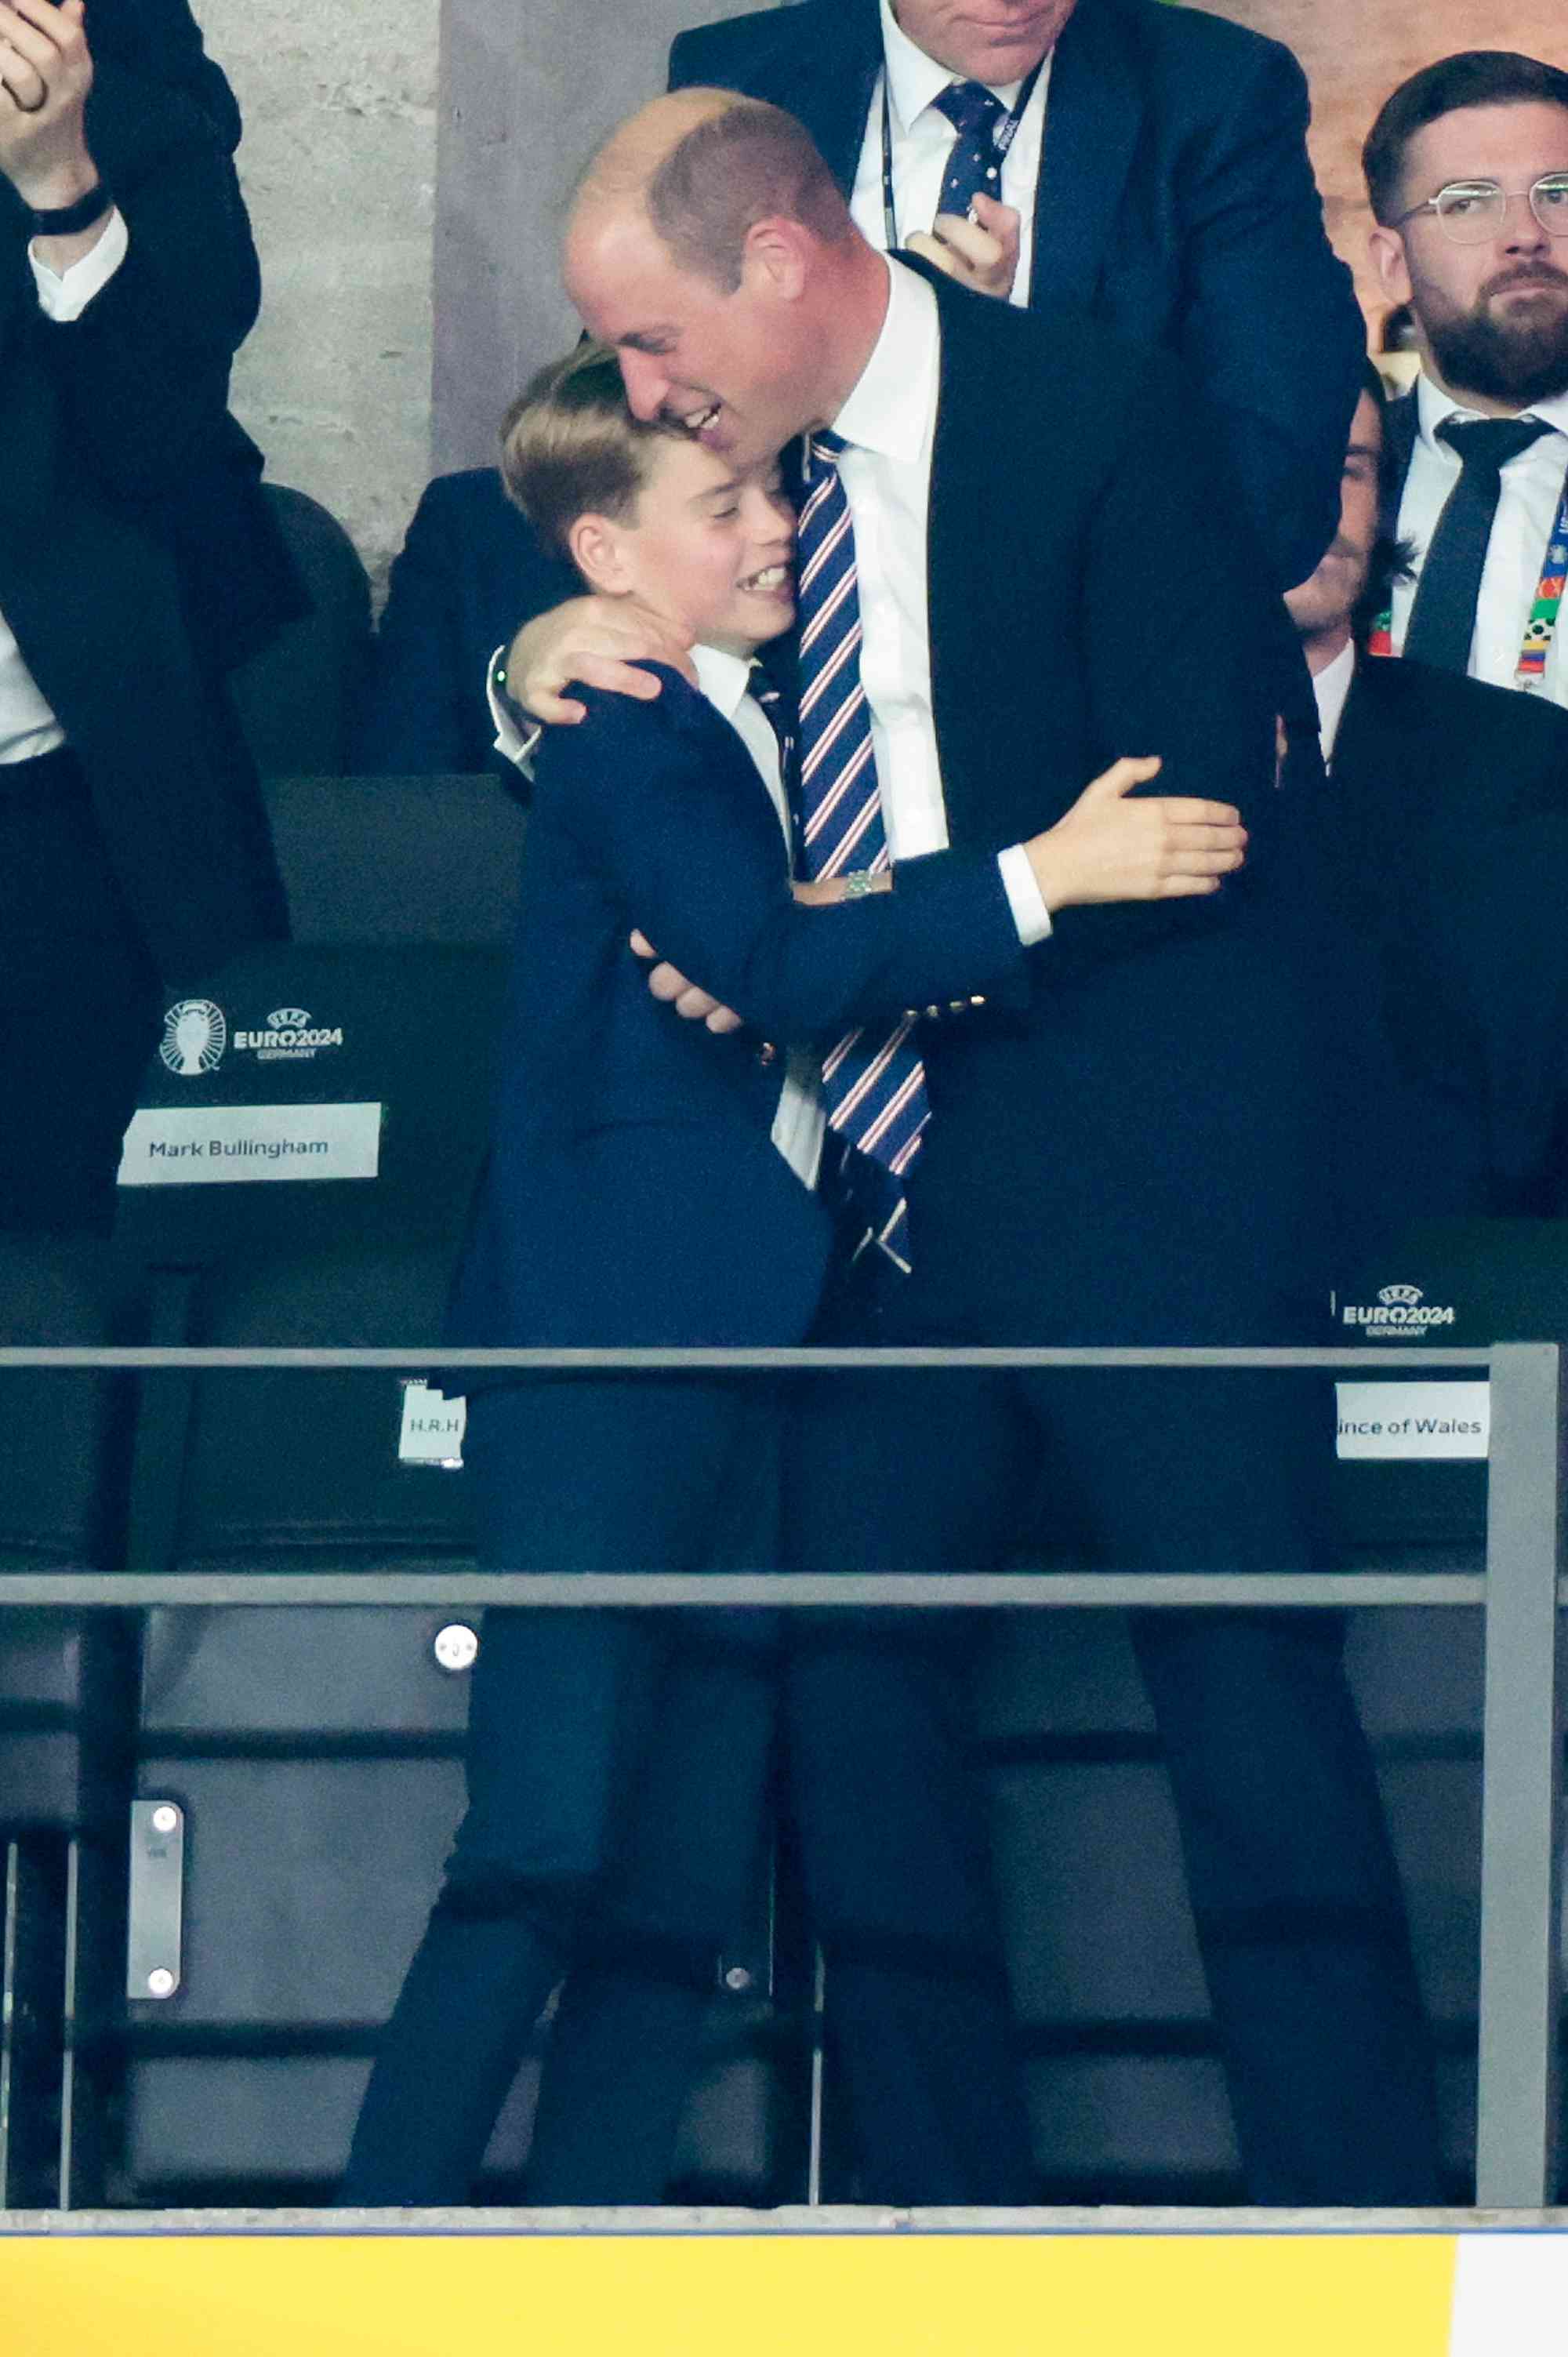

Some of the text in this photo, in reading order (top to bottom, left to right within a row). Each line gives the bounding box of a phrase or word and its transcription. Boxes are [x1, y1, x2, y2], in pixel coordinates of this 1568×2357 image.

[234, 1028, 343, 1049] EURO2024
[149, 1139, 328, 1158] Mark Bullingham
[1343, 1306, 1454, 1324] EURO2024
[1338, 1418, 1482, 1435] ince of Wales
